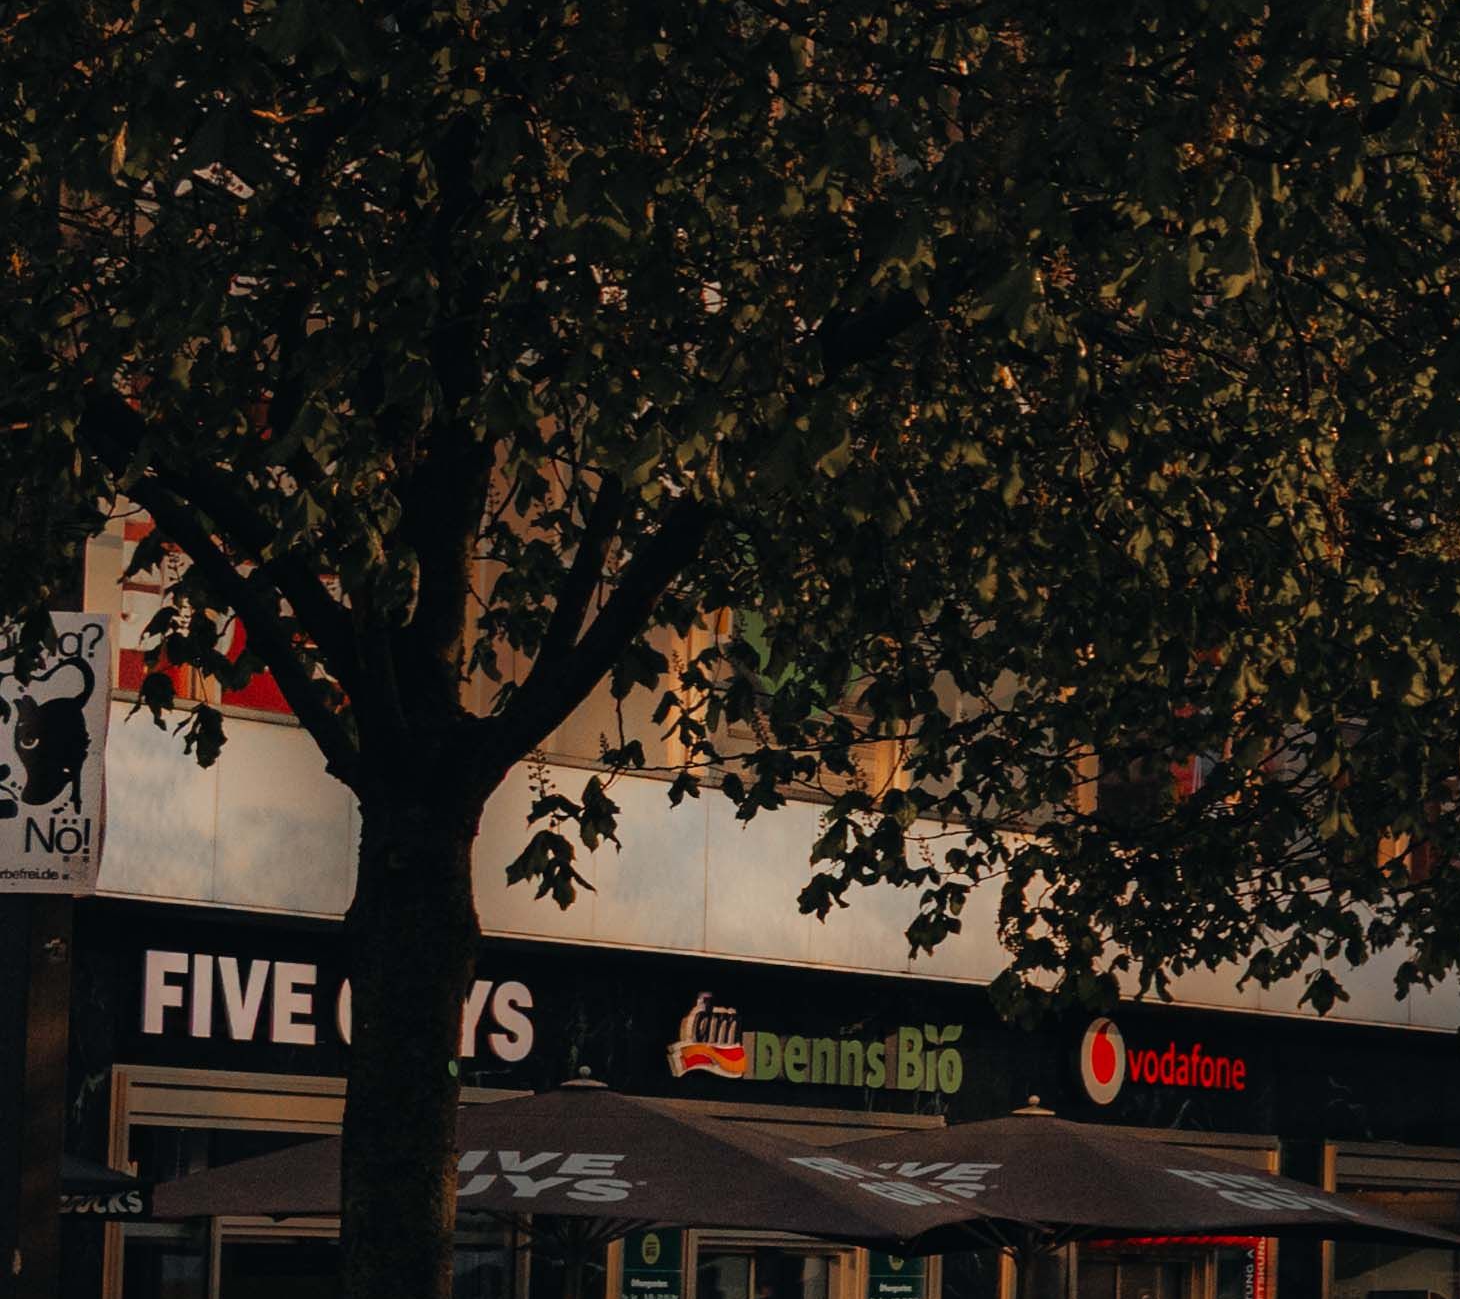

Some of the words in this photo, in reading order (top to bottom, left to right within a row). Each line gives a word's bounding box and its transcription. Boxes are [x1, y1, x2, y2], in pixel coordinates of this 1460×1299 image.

[24, 817, 91, 854] Nö!
[141, 949, 317, 1045] FIVE
[1127, 1040, 1247, 1092] vodafone
[457, 1150, 627, 1177] IVE
